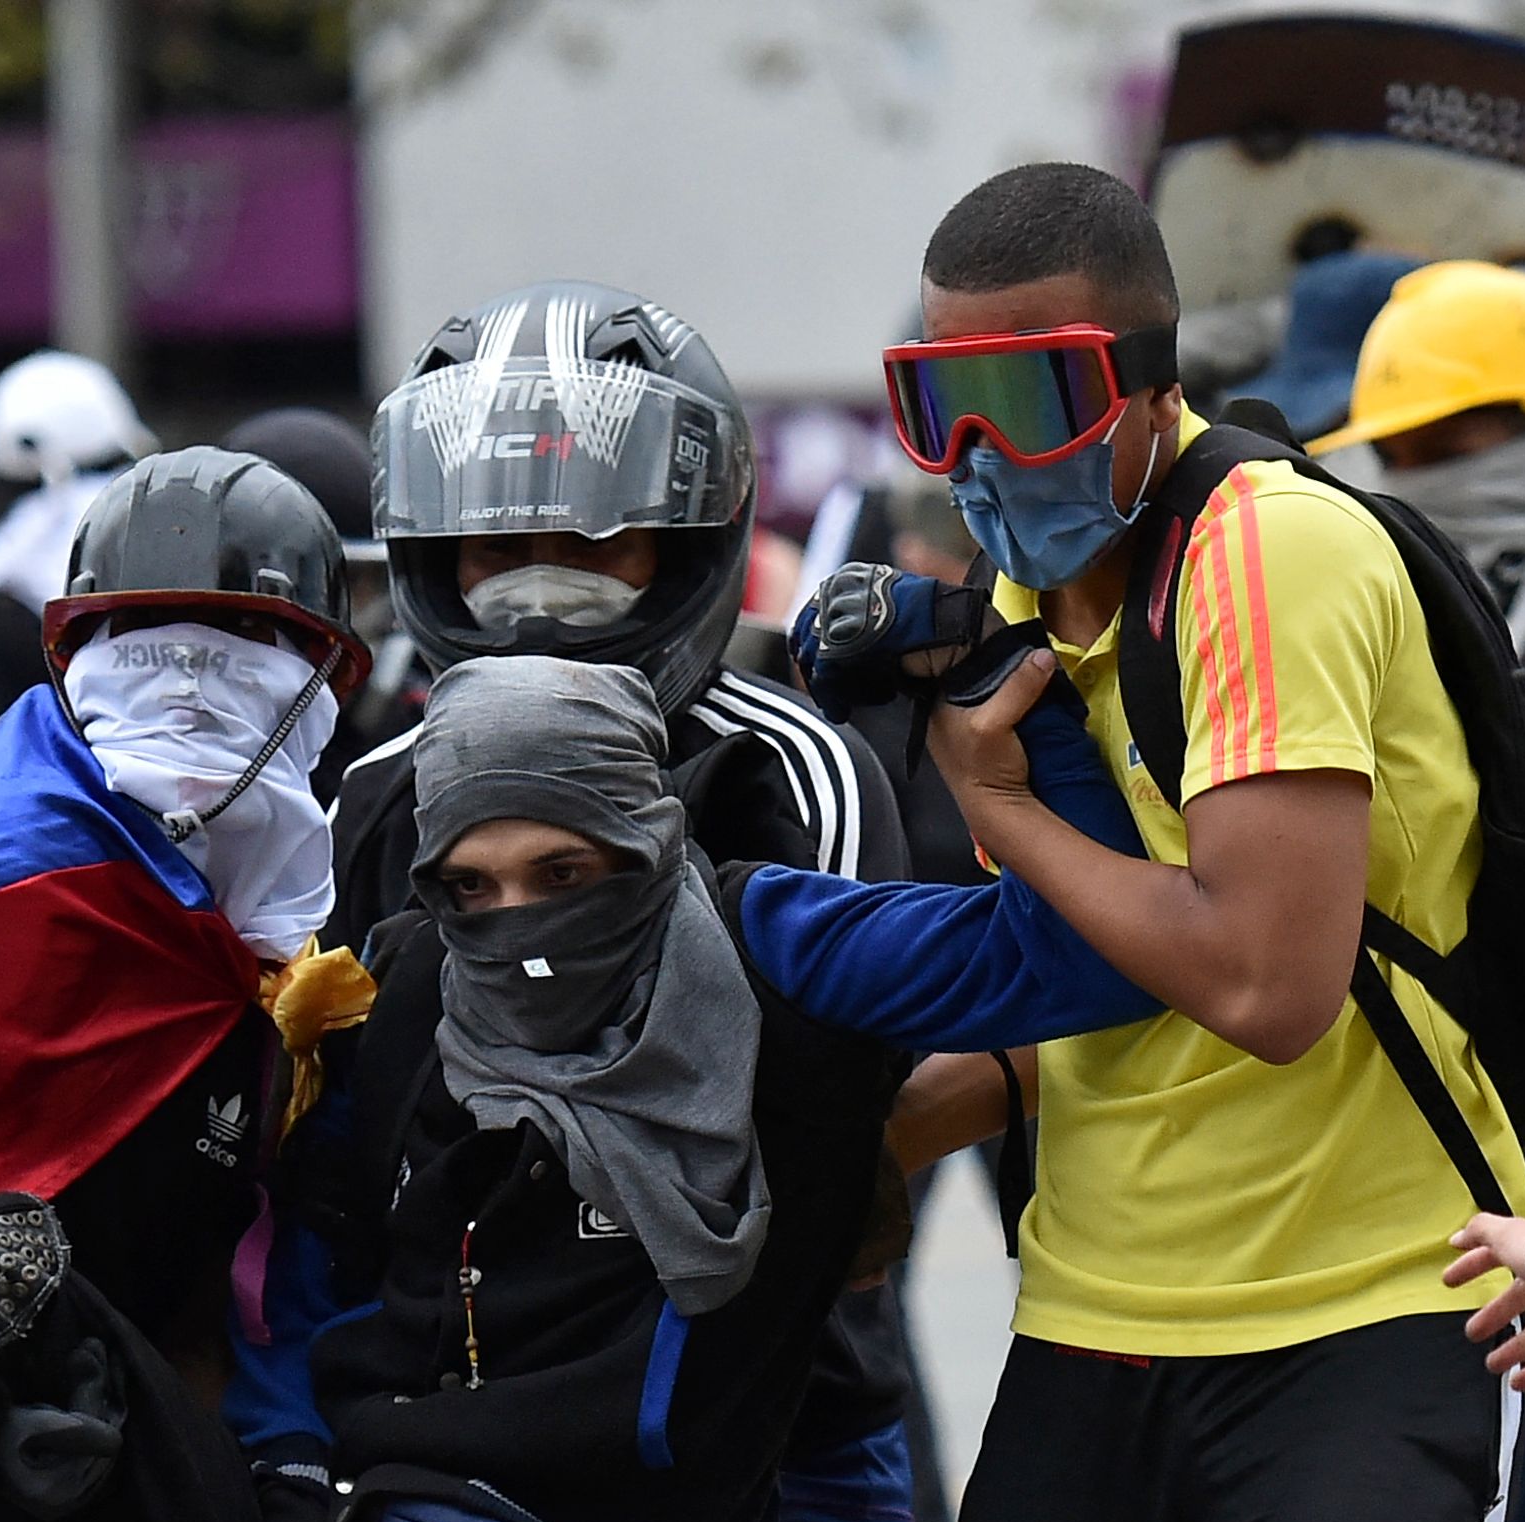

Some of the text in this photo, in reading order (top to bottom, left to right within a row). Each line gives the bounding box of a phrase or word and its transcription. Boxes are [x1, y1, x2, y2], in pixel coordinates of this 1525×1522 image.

[459, 504, 572, 520] ENJOY THE RIDE
